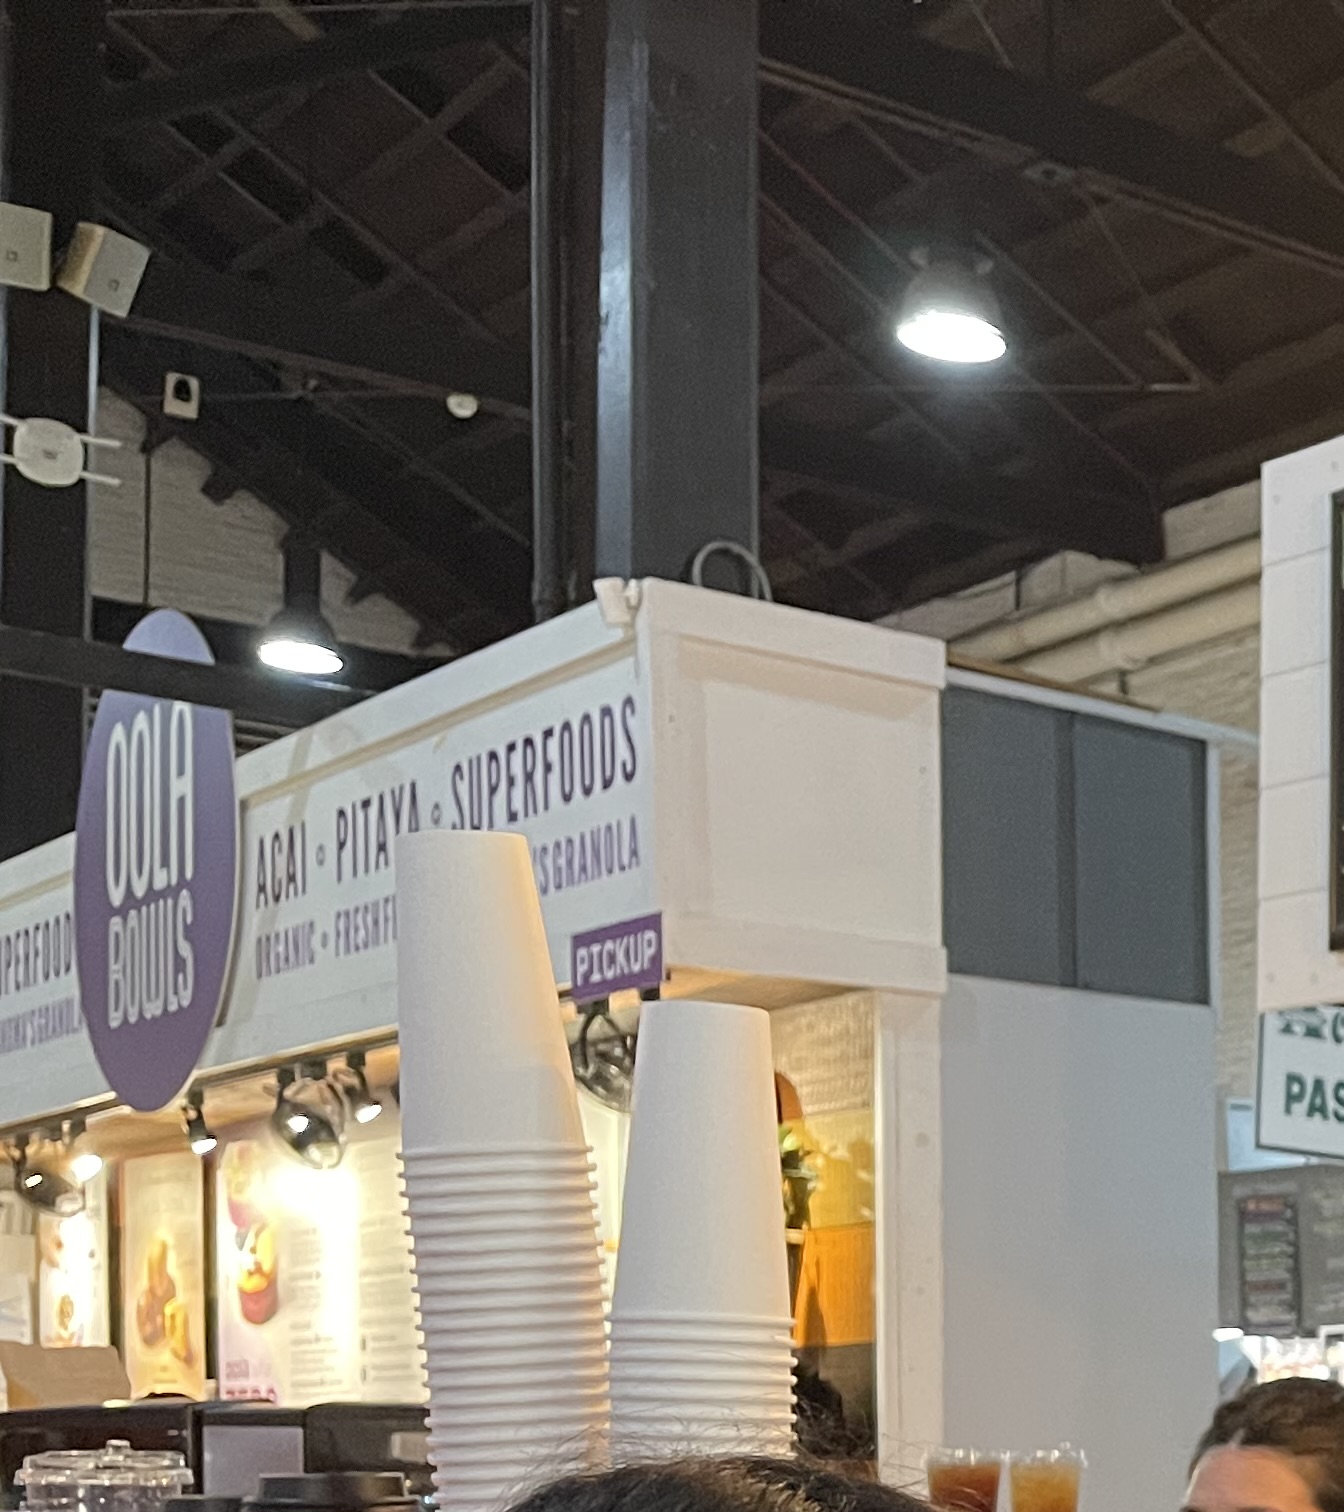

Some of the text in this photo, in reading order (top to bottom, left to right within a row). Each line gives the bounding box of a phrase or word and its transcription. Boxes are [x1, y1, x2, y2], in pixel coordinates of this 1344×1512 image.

[106, 701, 194, 909] OOLA
[256, 693, 638, 910] ACAI PITAYA SUPERFOODS
[0, 911, 72, 996] PERFOOD
[107, 888, 195, 1030] BOWLS
[256, 919, 316, 981] ORGANIC
[575, 929, 657, 987] PICKUP
